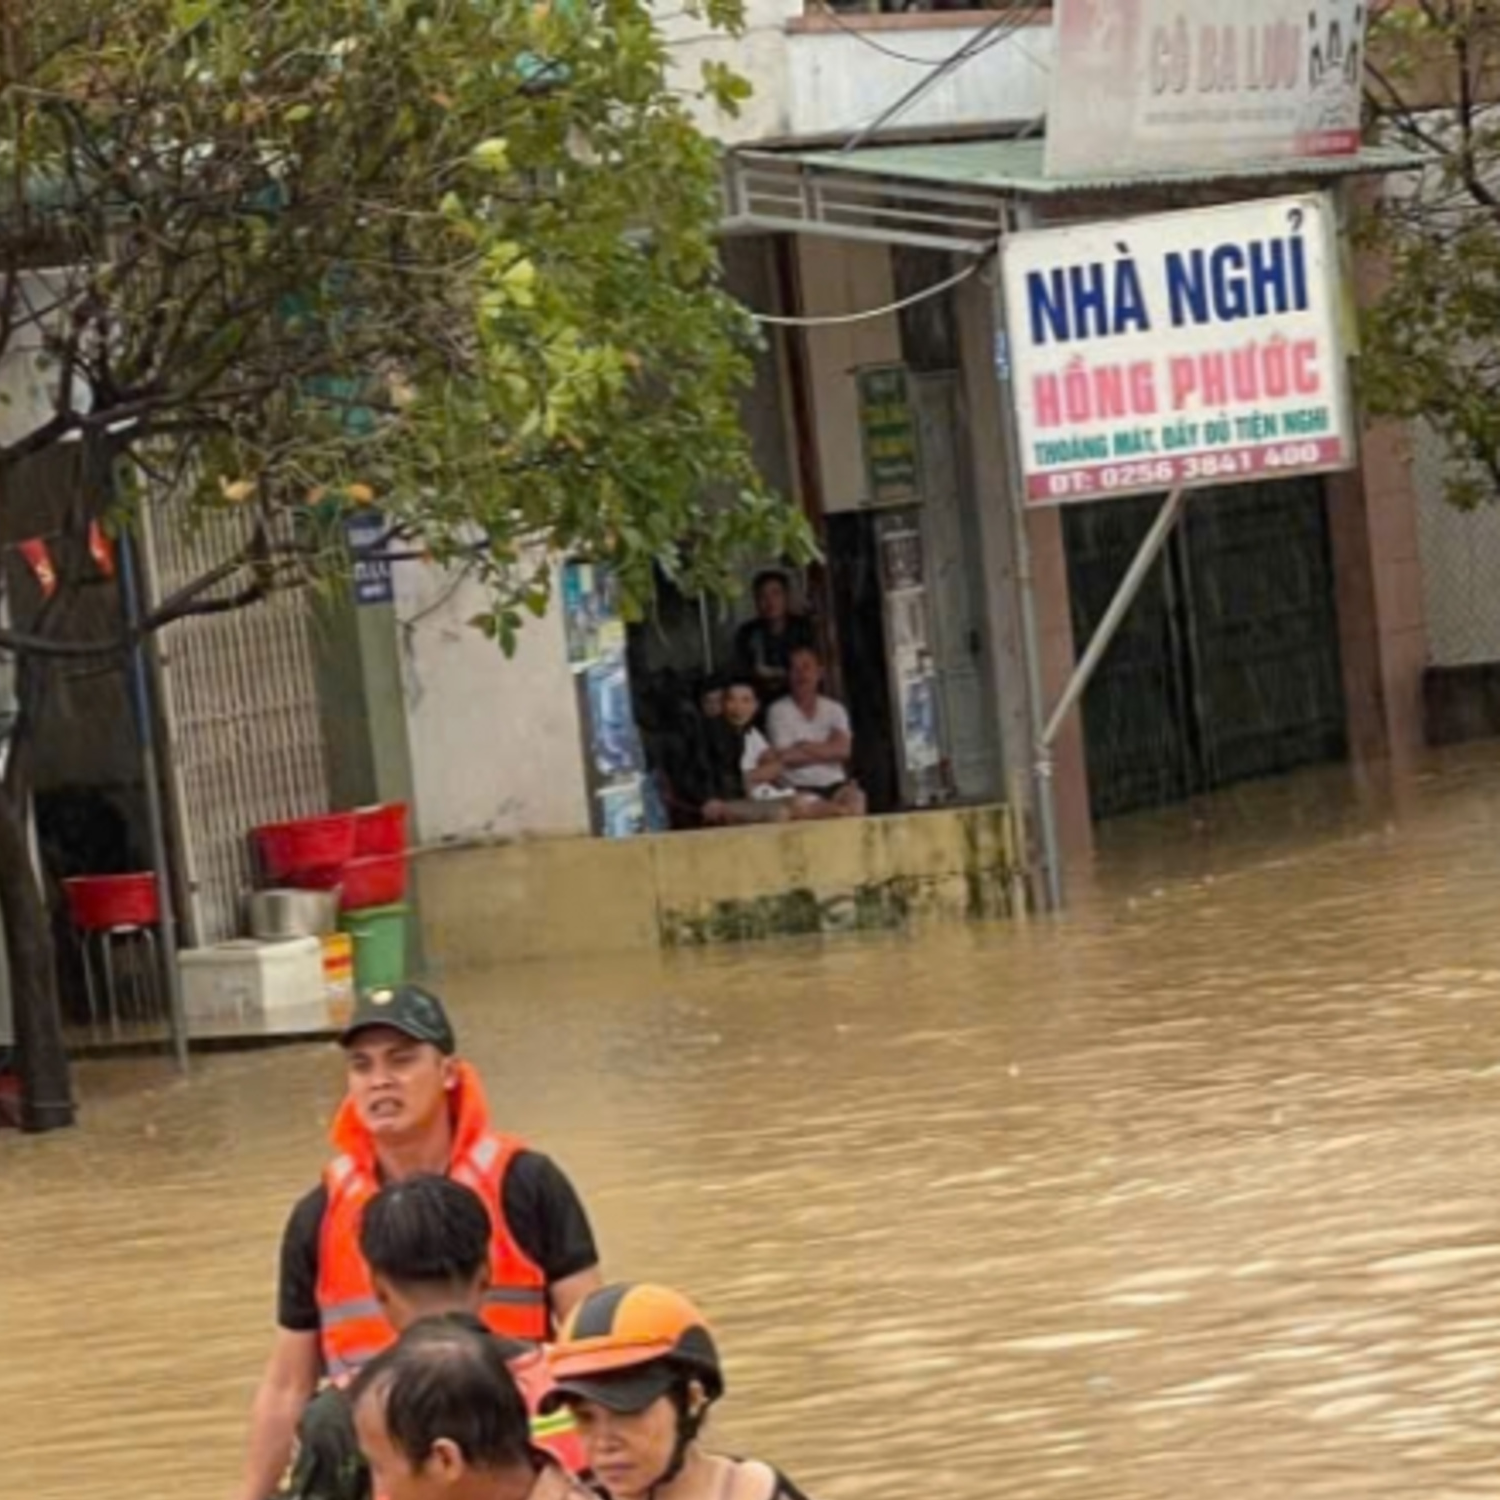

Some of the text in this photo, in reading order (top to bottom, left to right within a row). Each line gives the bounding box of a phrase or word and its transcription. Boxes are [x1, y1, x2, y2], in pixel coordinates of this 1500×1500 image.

[1026, 208, 1309, 345] NHÀ NGHỈ
[1033, 352, 1158, 428] HỒNG
[1169, 332, 1321, 411] PHƯỚC
[1034, 433, 1109, 466] THOÁNG
[1234, 407, 1278, 442] TIỆN
[1282, 406, 1329, 434] NGHI
[1101, 459, 1174, 489] 0256
[1182, 450, 1251, 479] 3841
